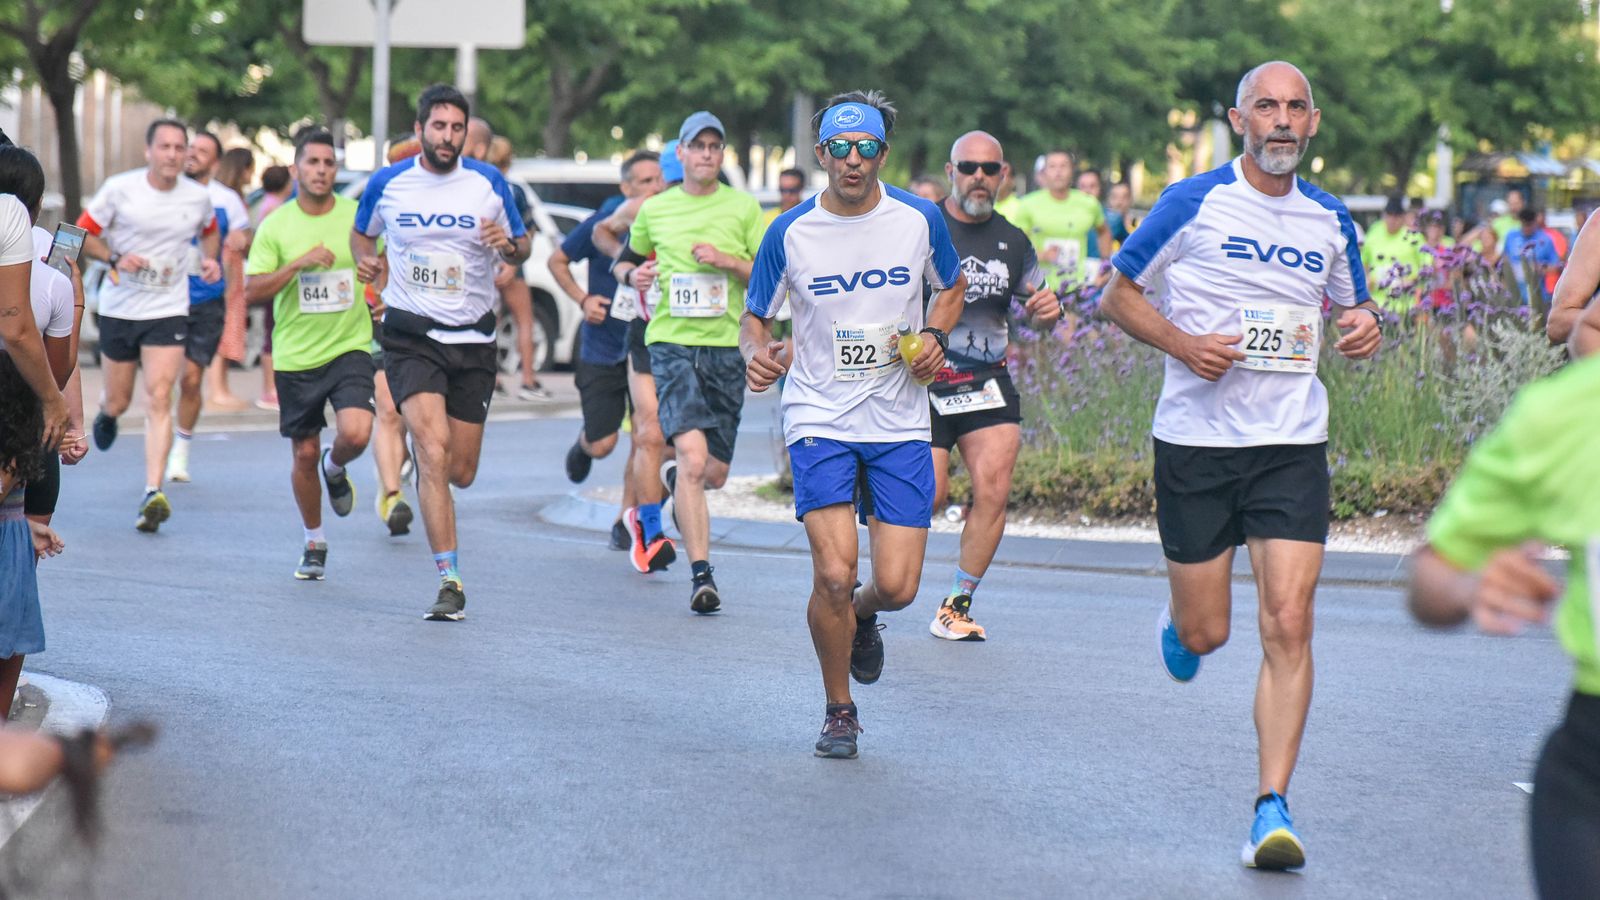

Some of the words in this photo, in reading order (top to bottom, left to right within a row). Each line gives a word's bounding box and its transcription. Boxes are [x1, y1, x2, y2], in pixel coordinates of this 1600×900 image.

[396, 213, 475, 229] EVOS
[1220, 235, 1325, 273] EVOS
[412, 265, 438, 285] 861
[807, 266, 911, 296] EVOS
[303, 286, 329, 302] 644
[675, 289, 699, 305] 191
[1244, 309, 1258, 319] XXI
[836, 329, 850, 339] XXI
[1246, 327, 1283, 352] 225
[841, 345, 877, 365] 522
